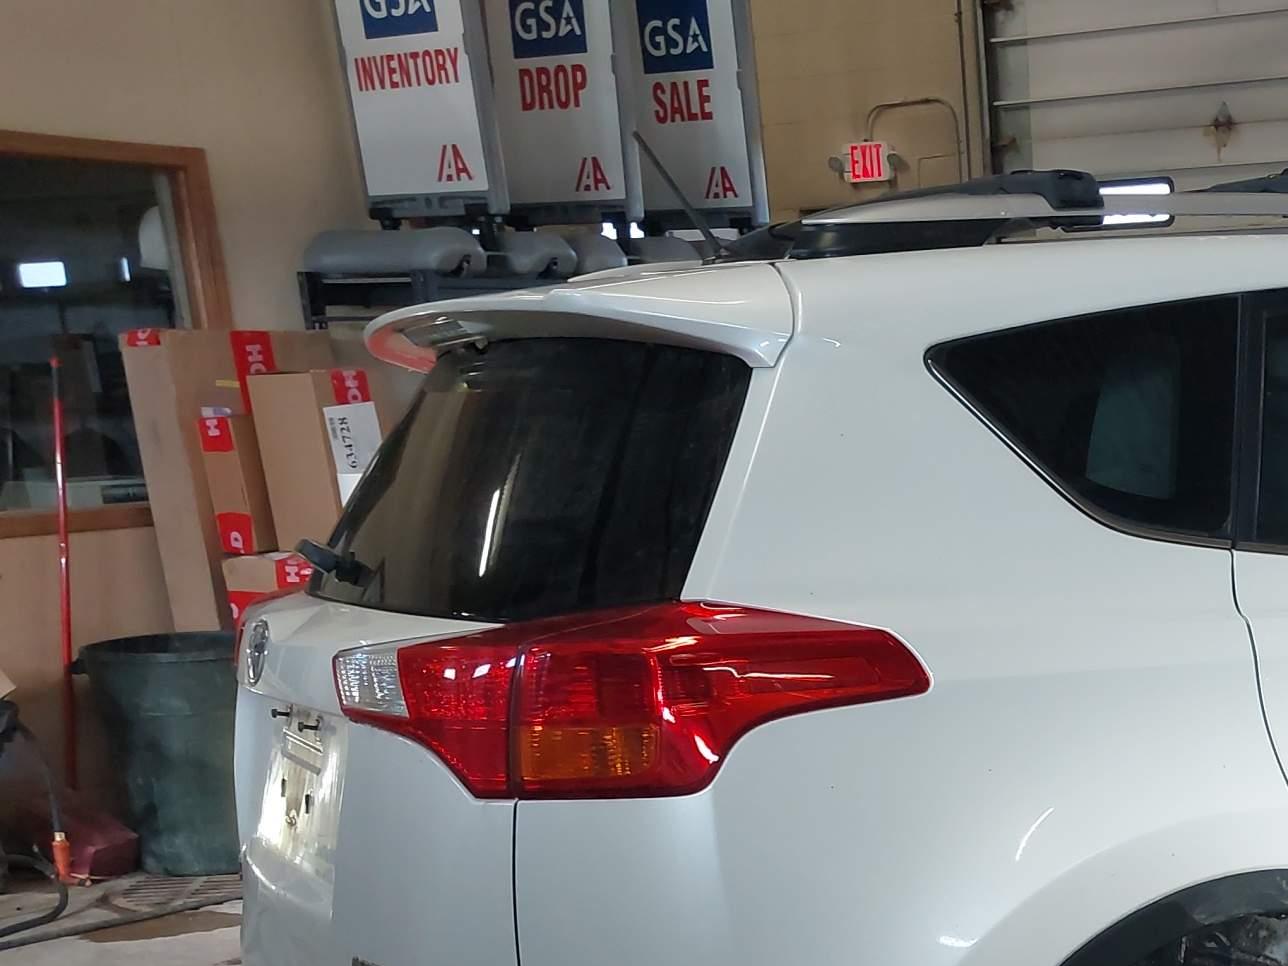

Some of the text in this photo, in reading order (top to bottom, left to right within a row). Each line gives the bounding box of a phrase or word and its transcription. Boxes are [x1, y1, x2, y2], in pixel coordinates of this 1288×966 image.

[514, 0, 582, 40] GSA
[643, 16, 708, 57] GSA
[354, 47, 460, 92] INVENTORY
[518, 64, 588, 112] DROP
[652, 79, 713, 124] SALE
[850, 143, 882, 179] EXIT
